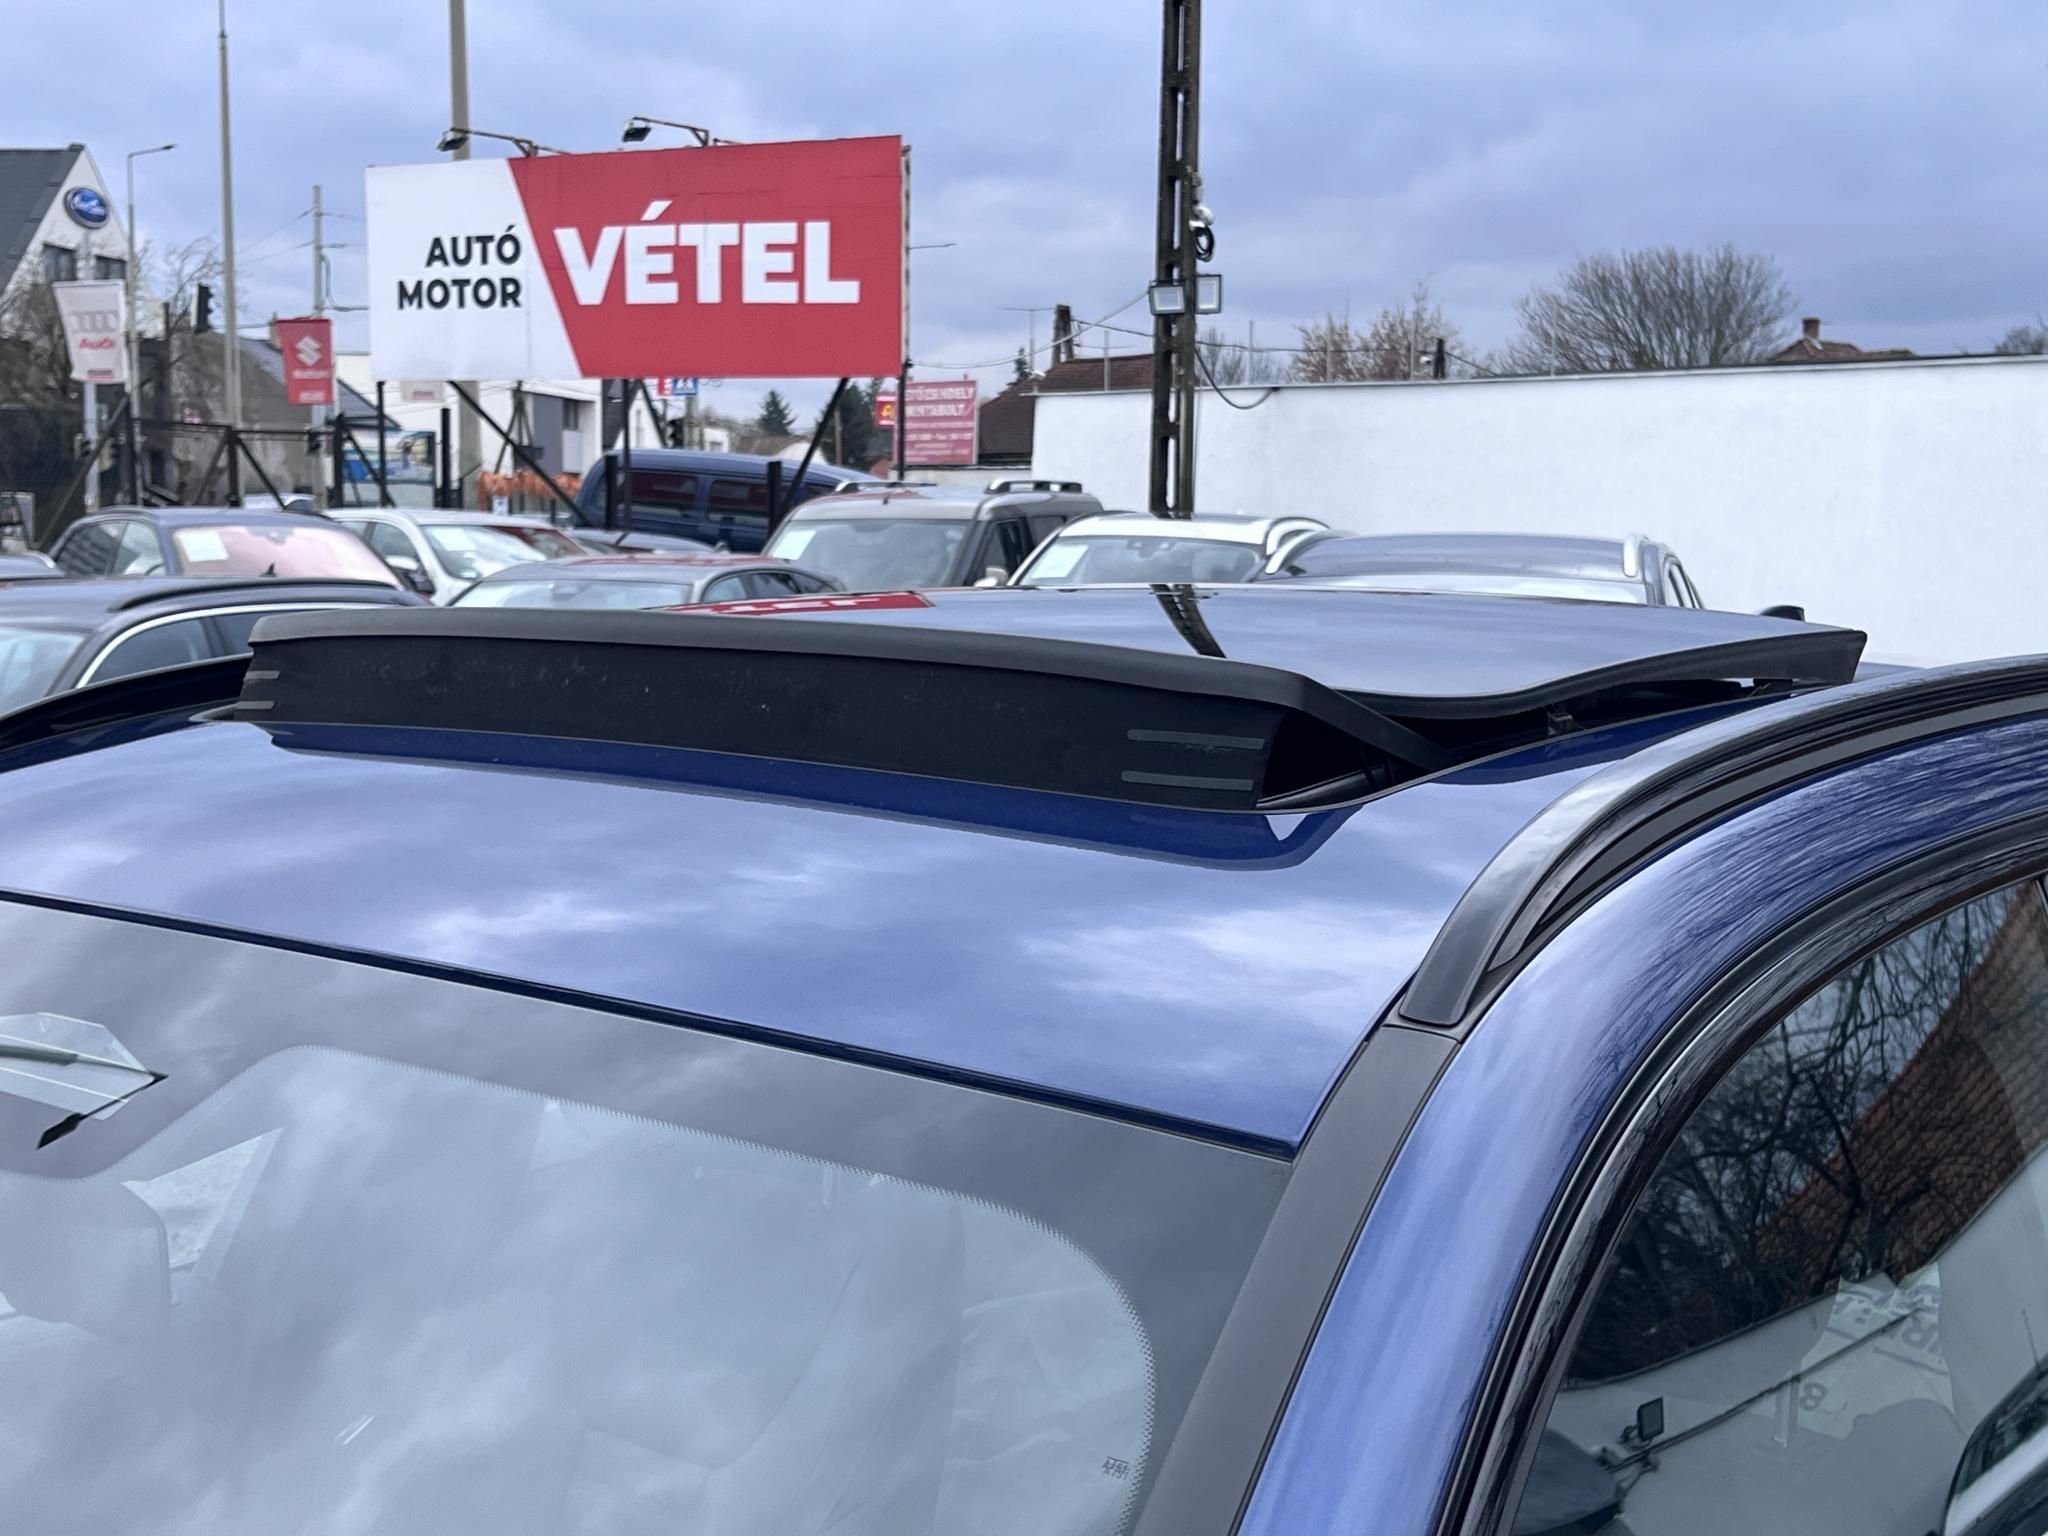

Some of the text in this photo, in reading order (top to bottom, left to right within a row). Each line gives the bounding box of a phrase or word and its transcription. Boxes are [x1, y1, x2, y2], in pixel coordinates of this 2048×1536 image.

[424, 224, 521, 268] AUTÓ
[553, 199, 860, 305] VÉTEL
[397, 277, 521, 310] MOTOR
